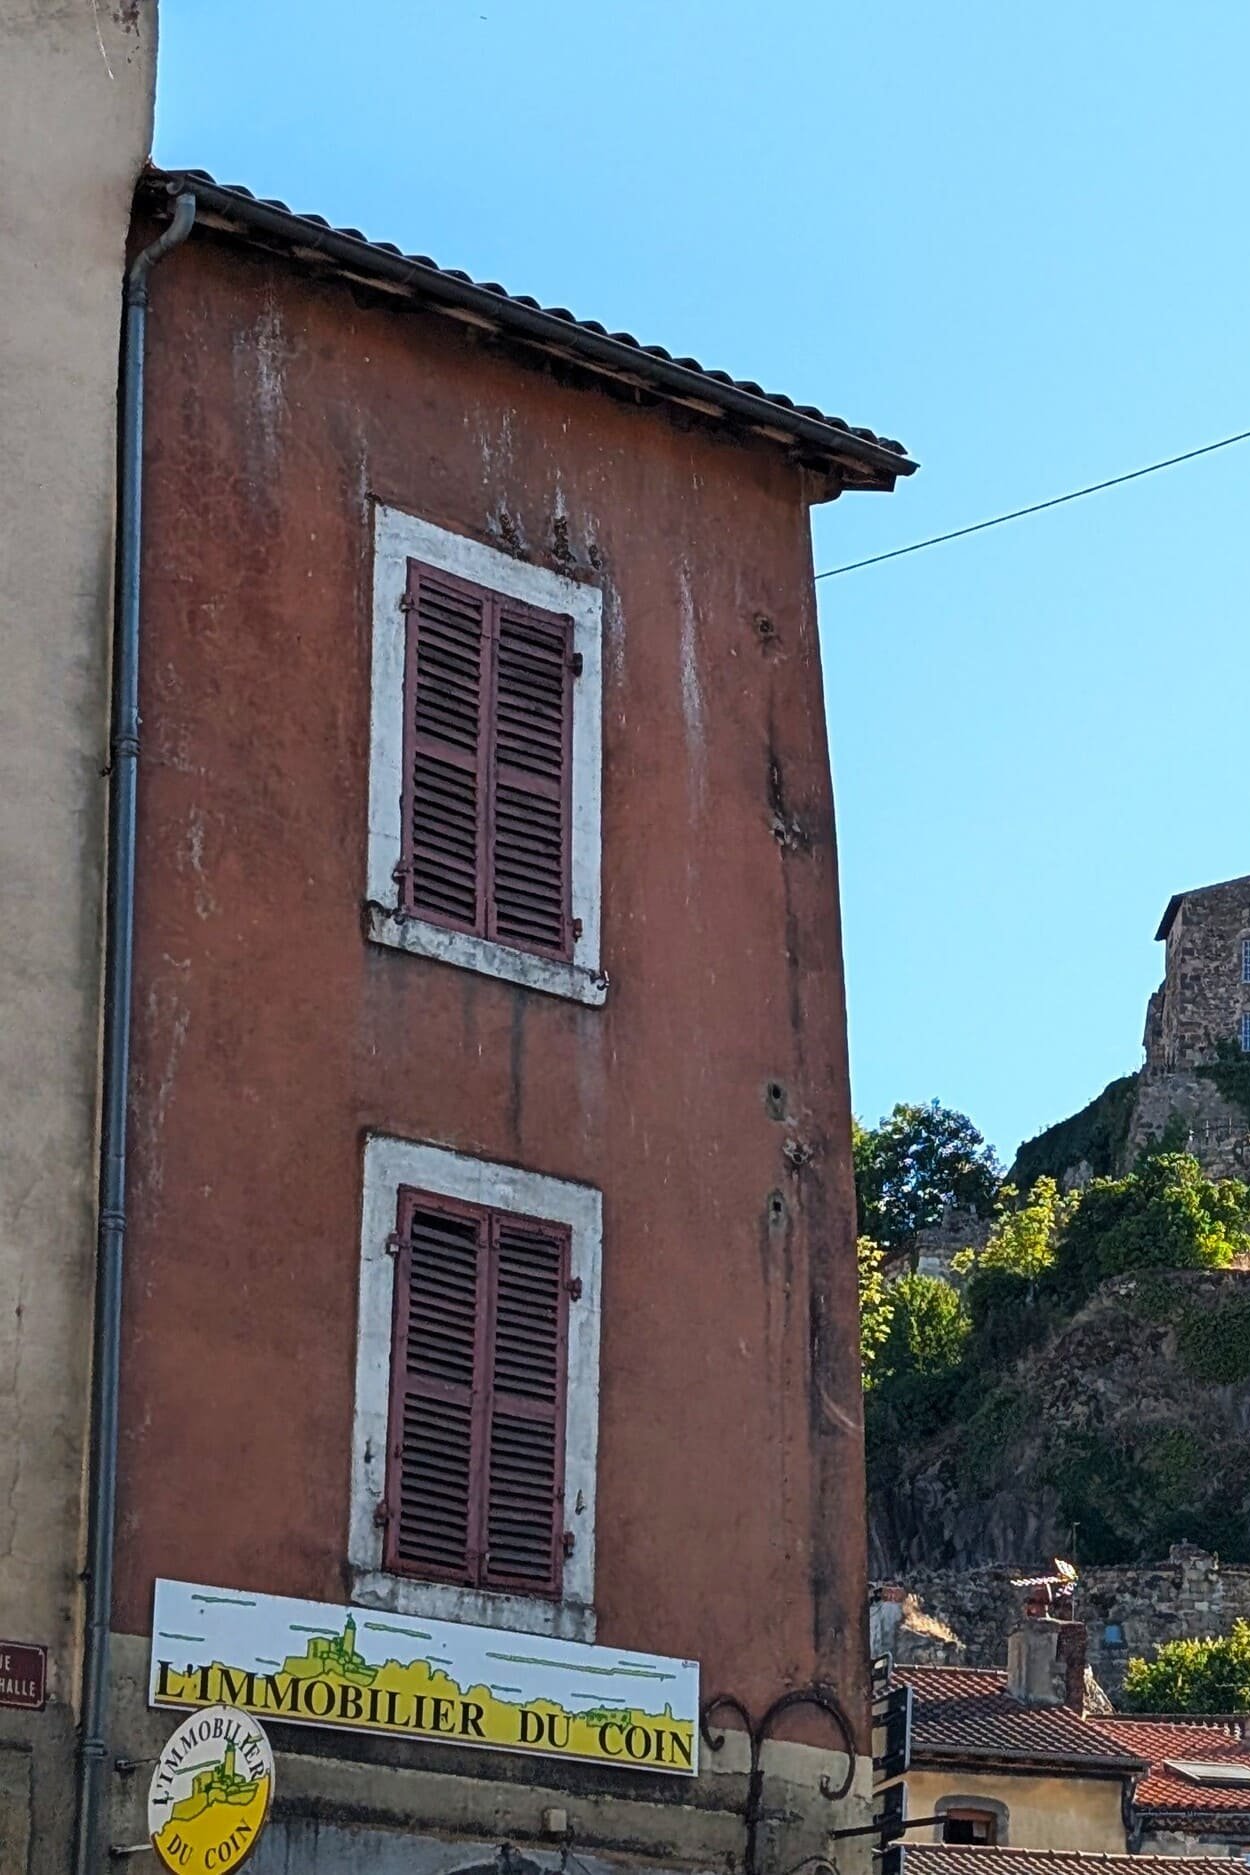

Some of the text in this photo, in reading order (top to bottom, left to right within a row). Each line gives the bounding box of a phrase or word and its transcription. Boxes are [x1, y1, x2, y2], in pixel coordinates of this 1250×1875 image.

[0, 1678, 36, 1697] HALLE
[157, 1660, 694, 1766] L'IMMOBILIER DU COIN
[153, 1718, 265, 1806] L'IMMOBILIER
[167, 1818, 252, 1869] DU COIN
